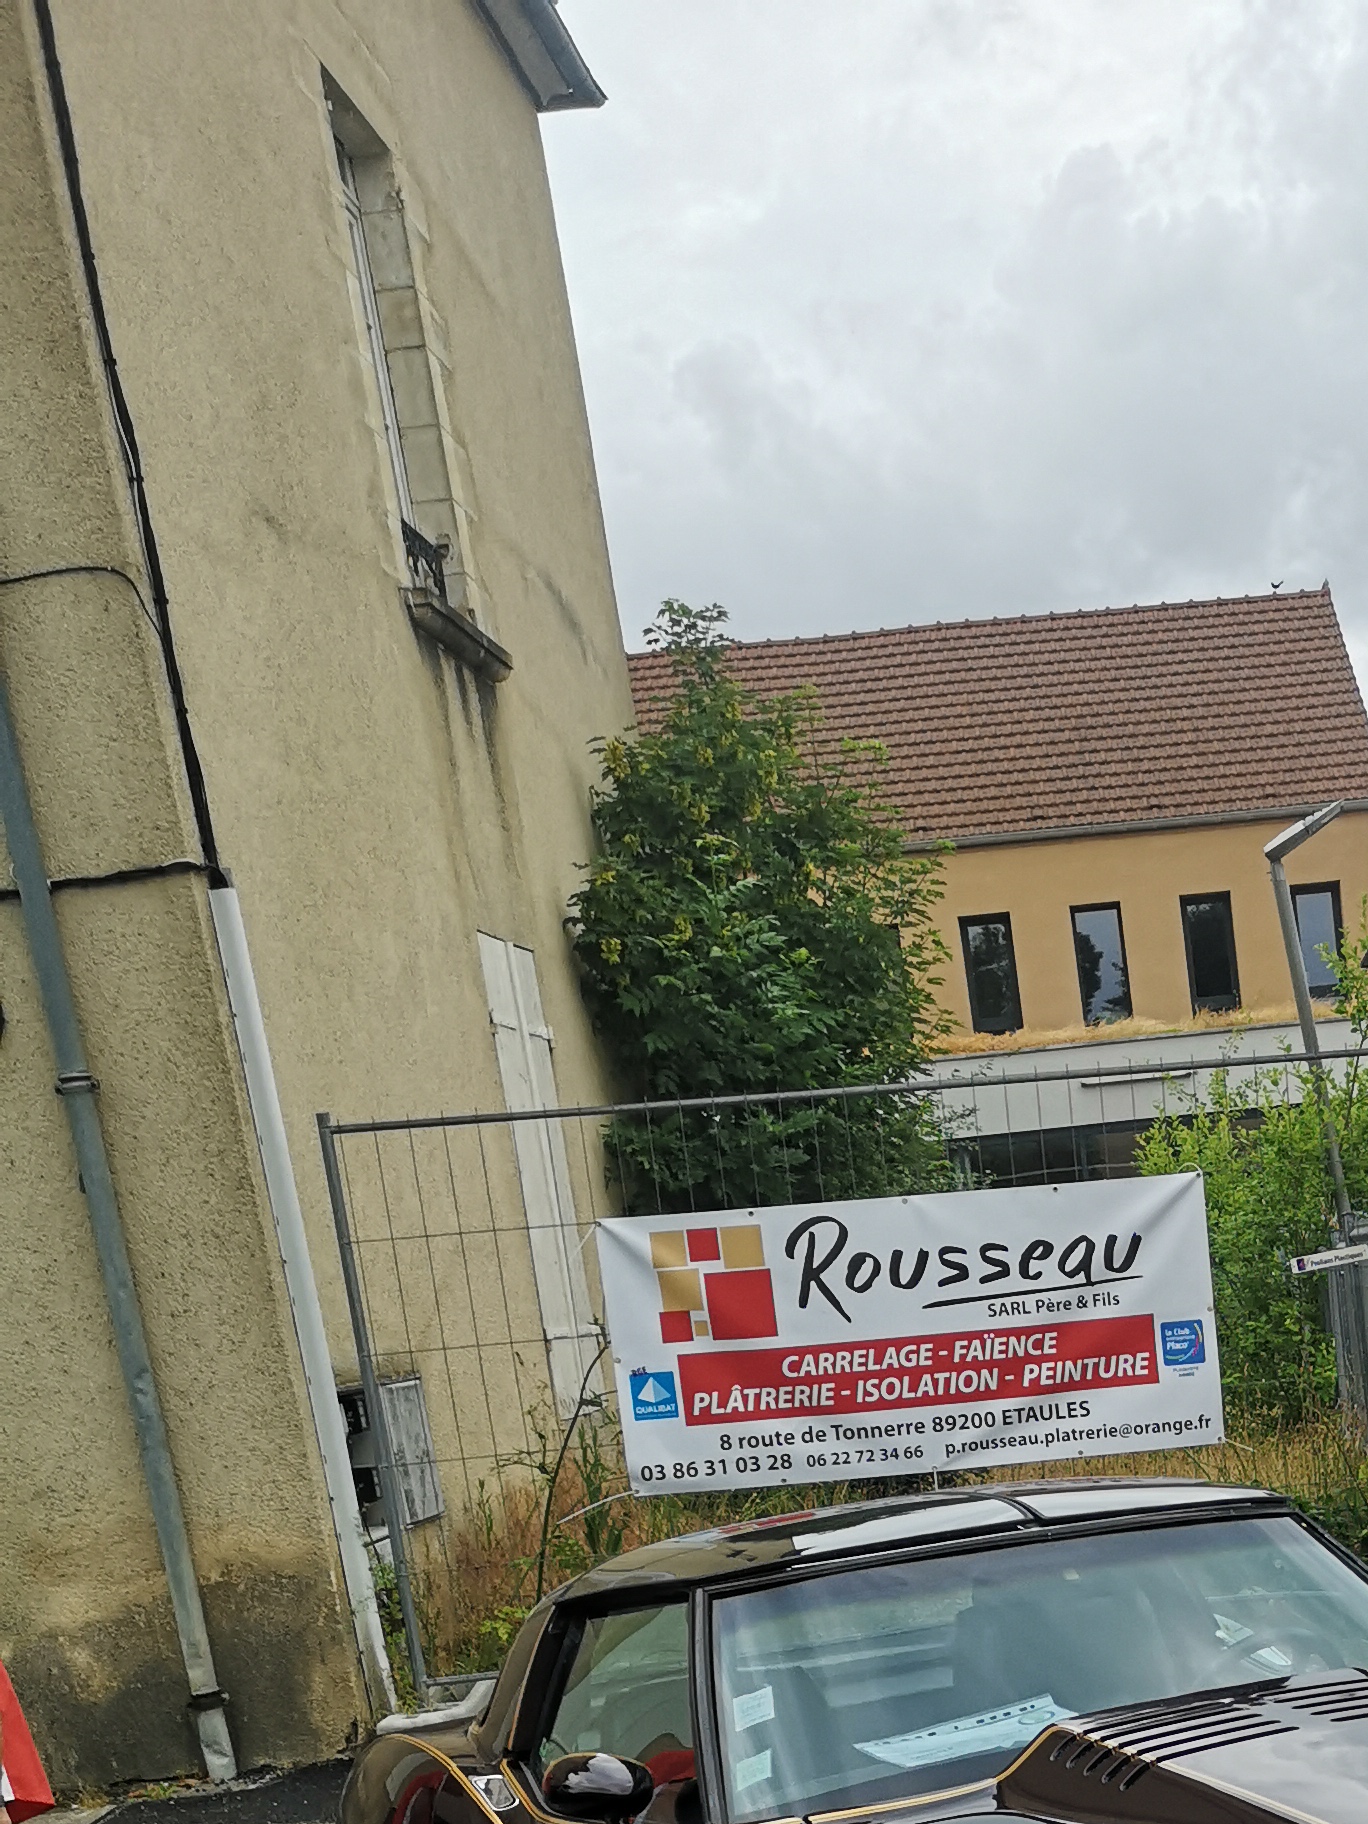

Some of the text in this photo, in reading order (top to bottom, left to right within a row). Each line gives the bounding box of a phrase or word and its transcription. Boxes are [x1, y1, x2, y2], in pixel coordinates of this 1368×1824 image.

[785, 1215, 1143, 1324] Rousseau
[987, 1291, 1121, 1318] SARL Père & Fils
[782, 1343, 934, 1378] CARRELAGE
[953, 1331, 1058, 1363] FAÏENCE
[635, 1403, 676, 1415] QUALIBAT
[692, 1382, 836, 1416] PLÂTRERIE
[856, 1367, 999, 1403] ISOLATION
[1022, 1351, 1150, 1387] PEINTURE
[640, 1413, 1212, 1482] 03 86 31 03 28 06 22 72 34 66 p.rousseau.platrerie@orange.fr
[720, 1400, 1091, 1451] 8 route de Tonnerre 89200 ETAULES
